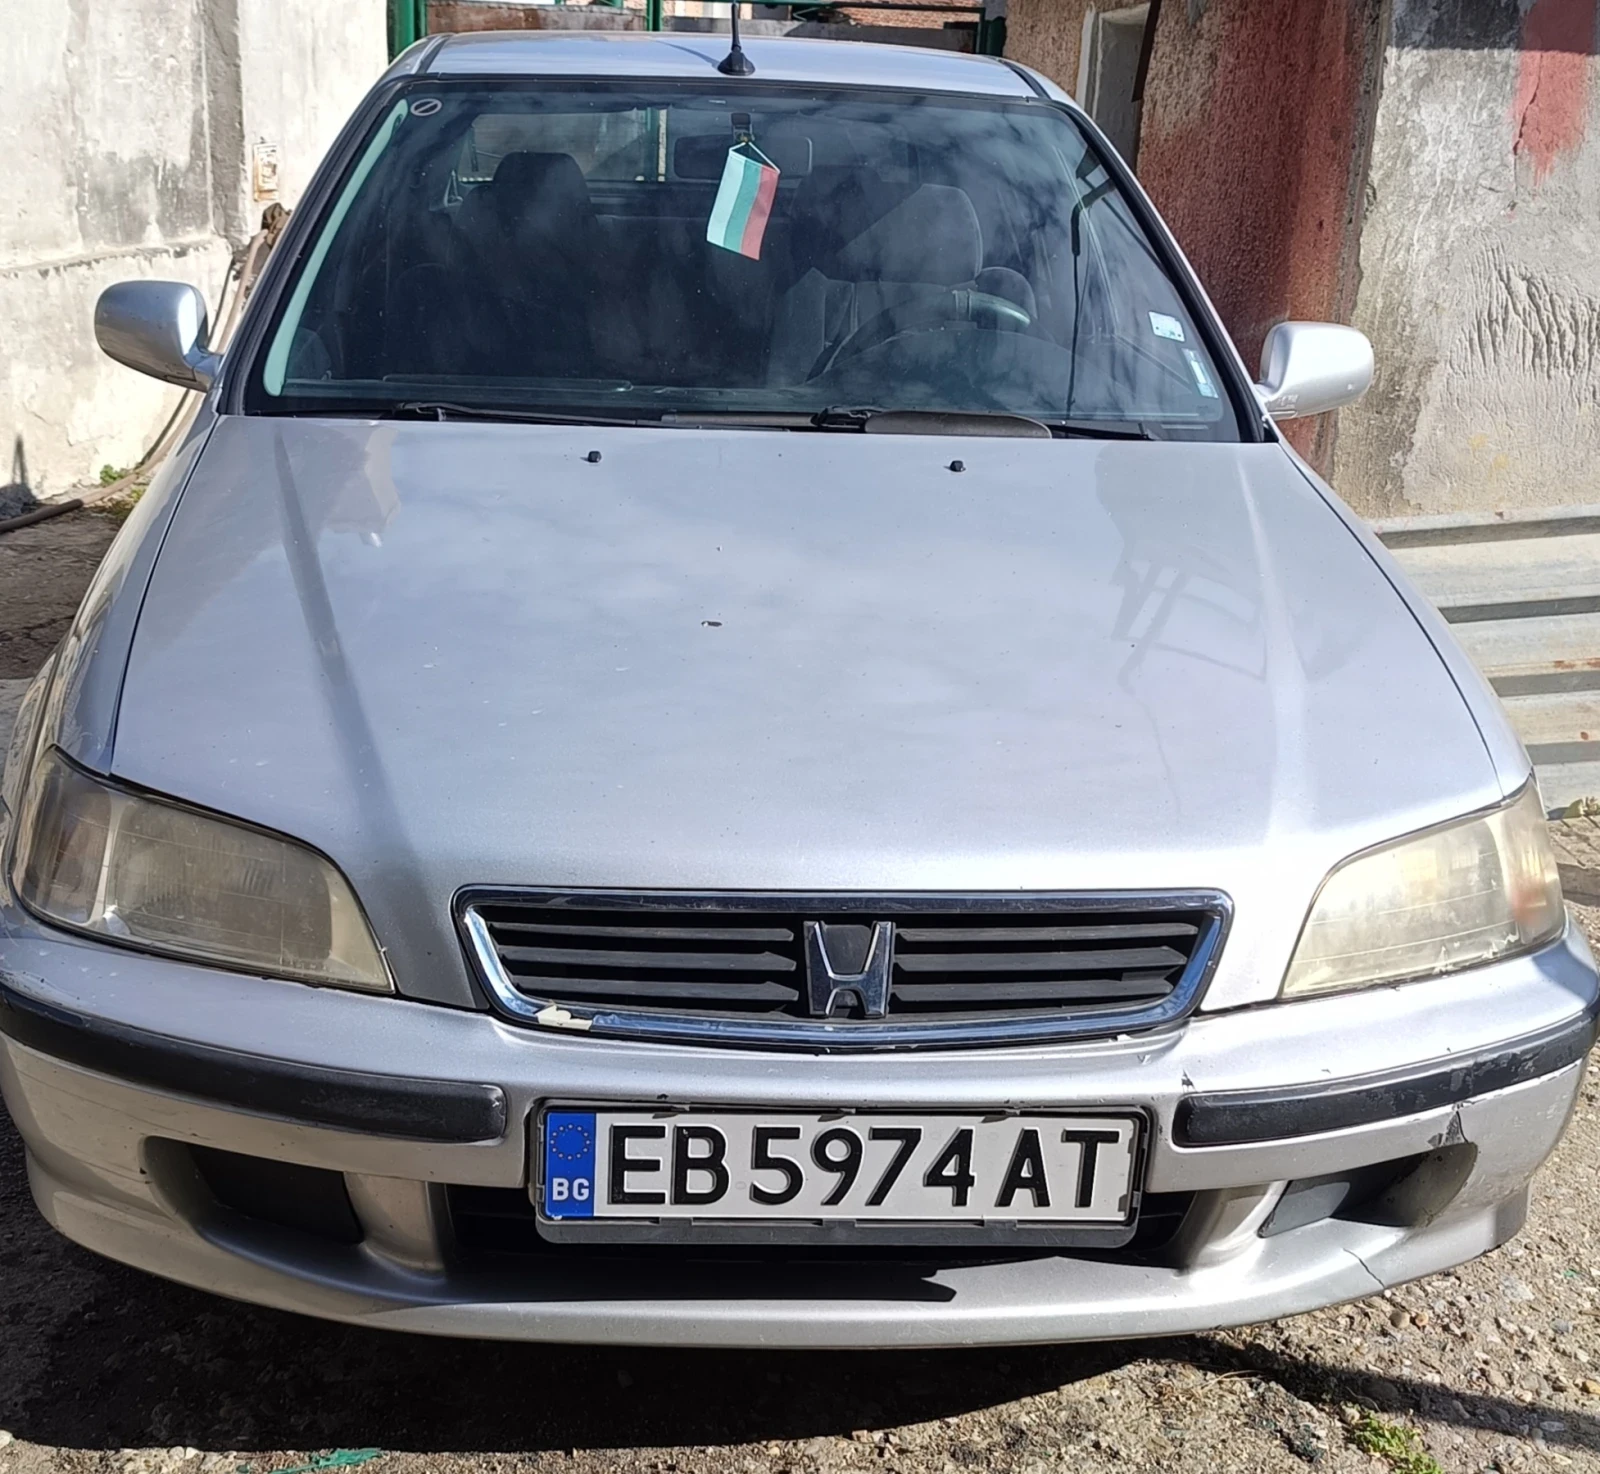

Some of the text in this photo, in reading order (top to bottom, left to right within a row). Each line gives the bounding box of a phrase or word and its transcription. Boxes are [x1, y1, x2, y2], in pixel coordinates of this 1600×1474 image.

[552, 1178, 590, 1201] BG
[607, 1124, 1121, 1208] EB 5974 AT
